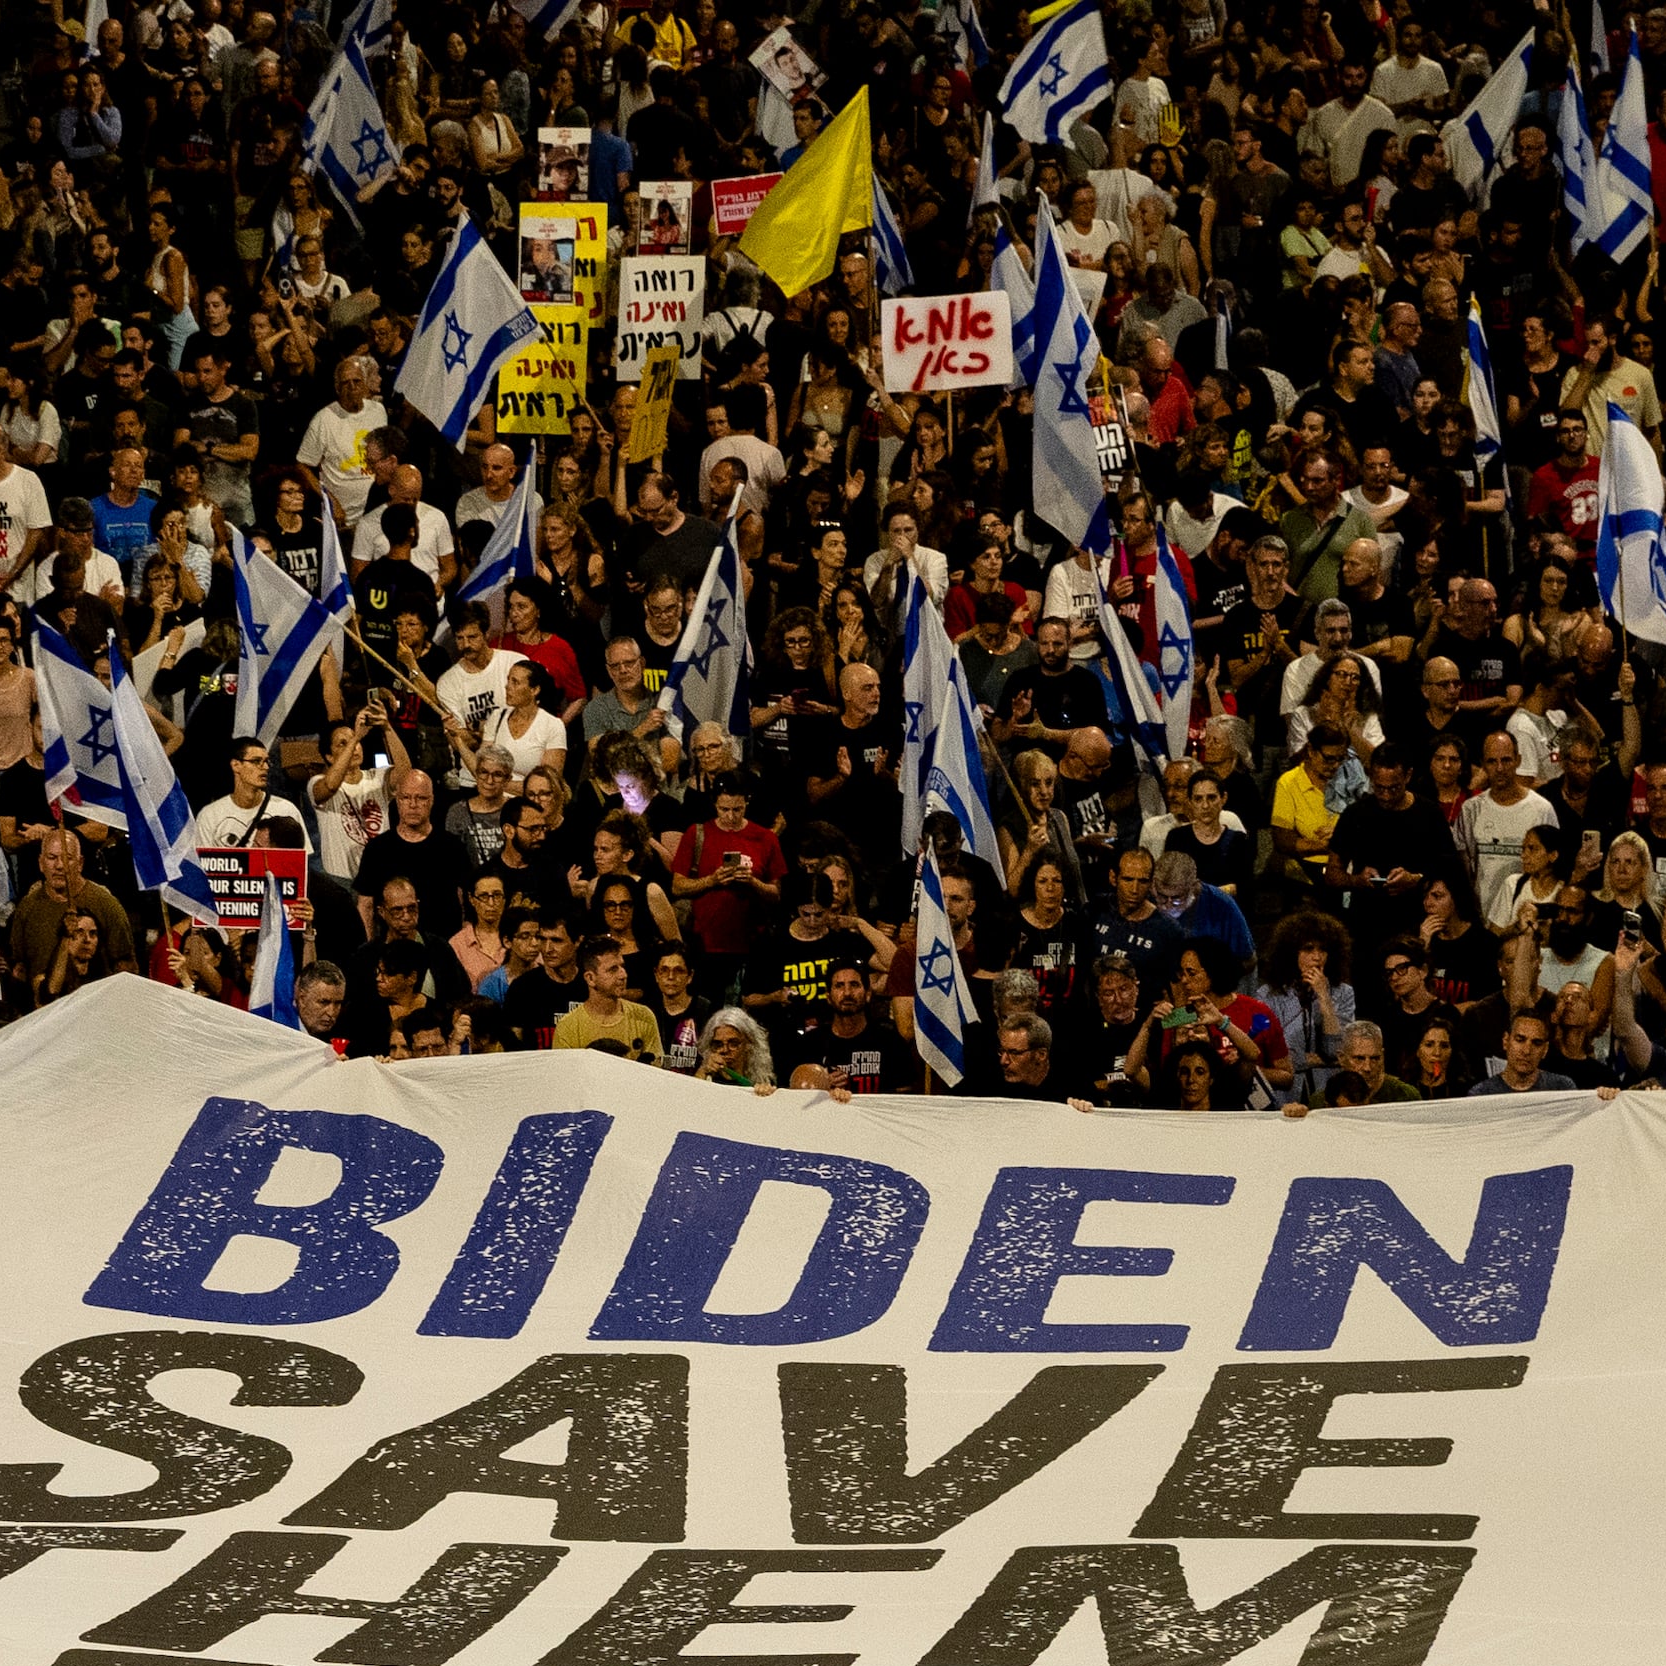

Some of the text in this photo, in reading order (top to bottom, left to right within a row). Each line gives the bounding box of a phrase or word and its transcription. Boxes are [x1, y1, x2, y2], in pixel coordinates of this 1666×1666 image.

[634, 270, 695, 292] רואה
[627, 300, 687, 323] ואינה
[897, 298, 994, 351] אמא
[516, 357, 577, 379] ואינה
[912, 345, 991, 391] כאן
[200, 856, 243, 876] WORLD,
[211, 879, 230, 894] OUR
[282, 881, 295, 895] IS
[783, 959, 831, 983] דחה
[82, 1096, 1574, 1353] BIDEN
